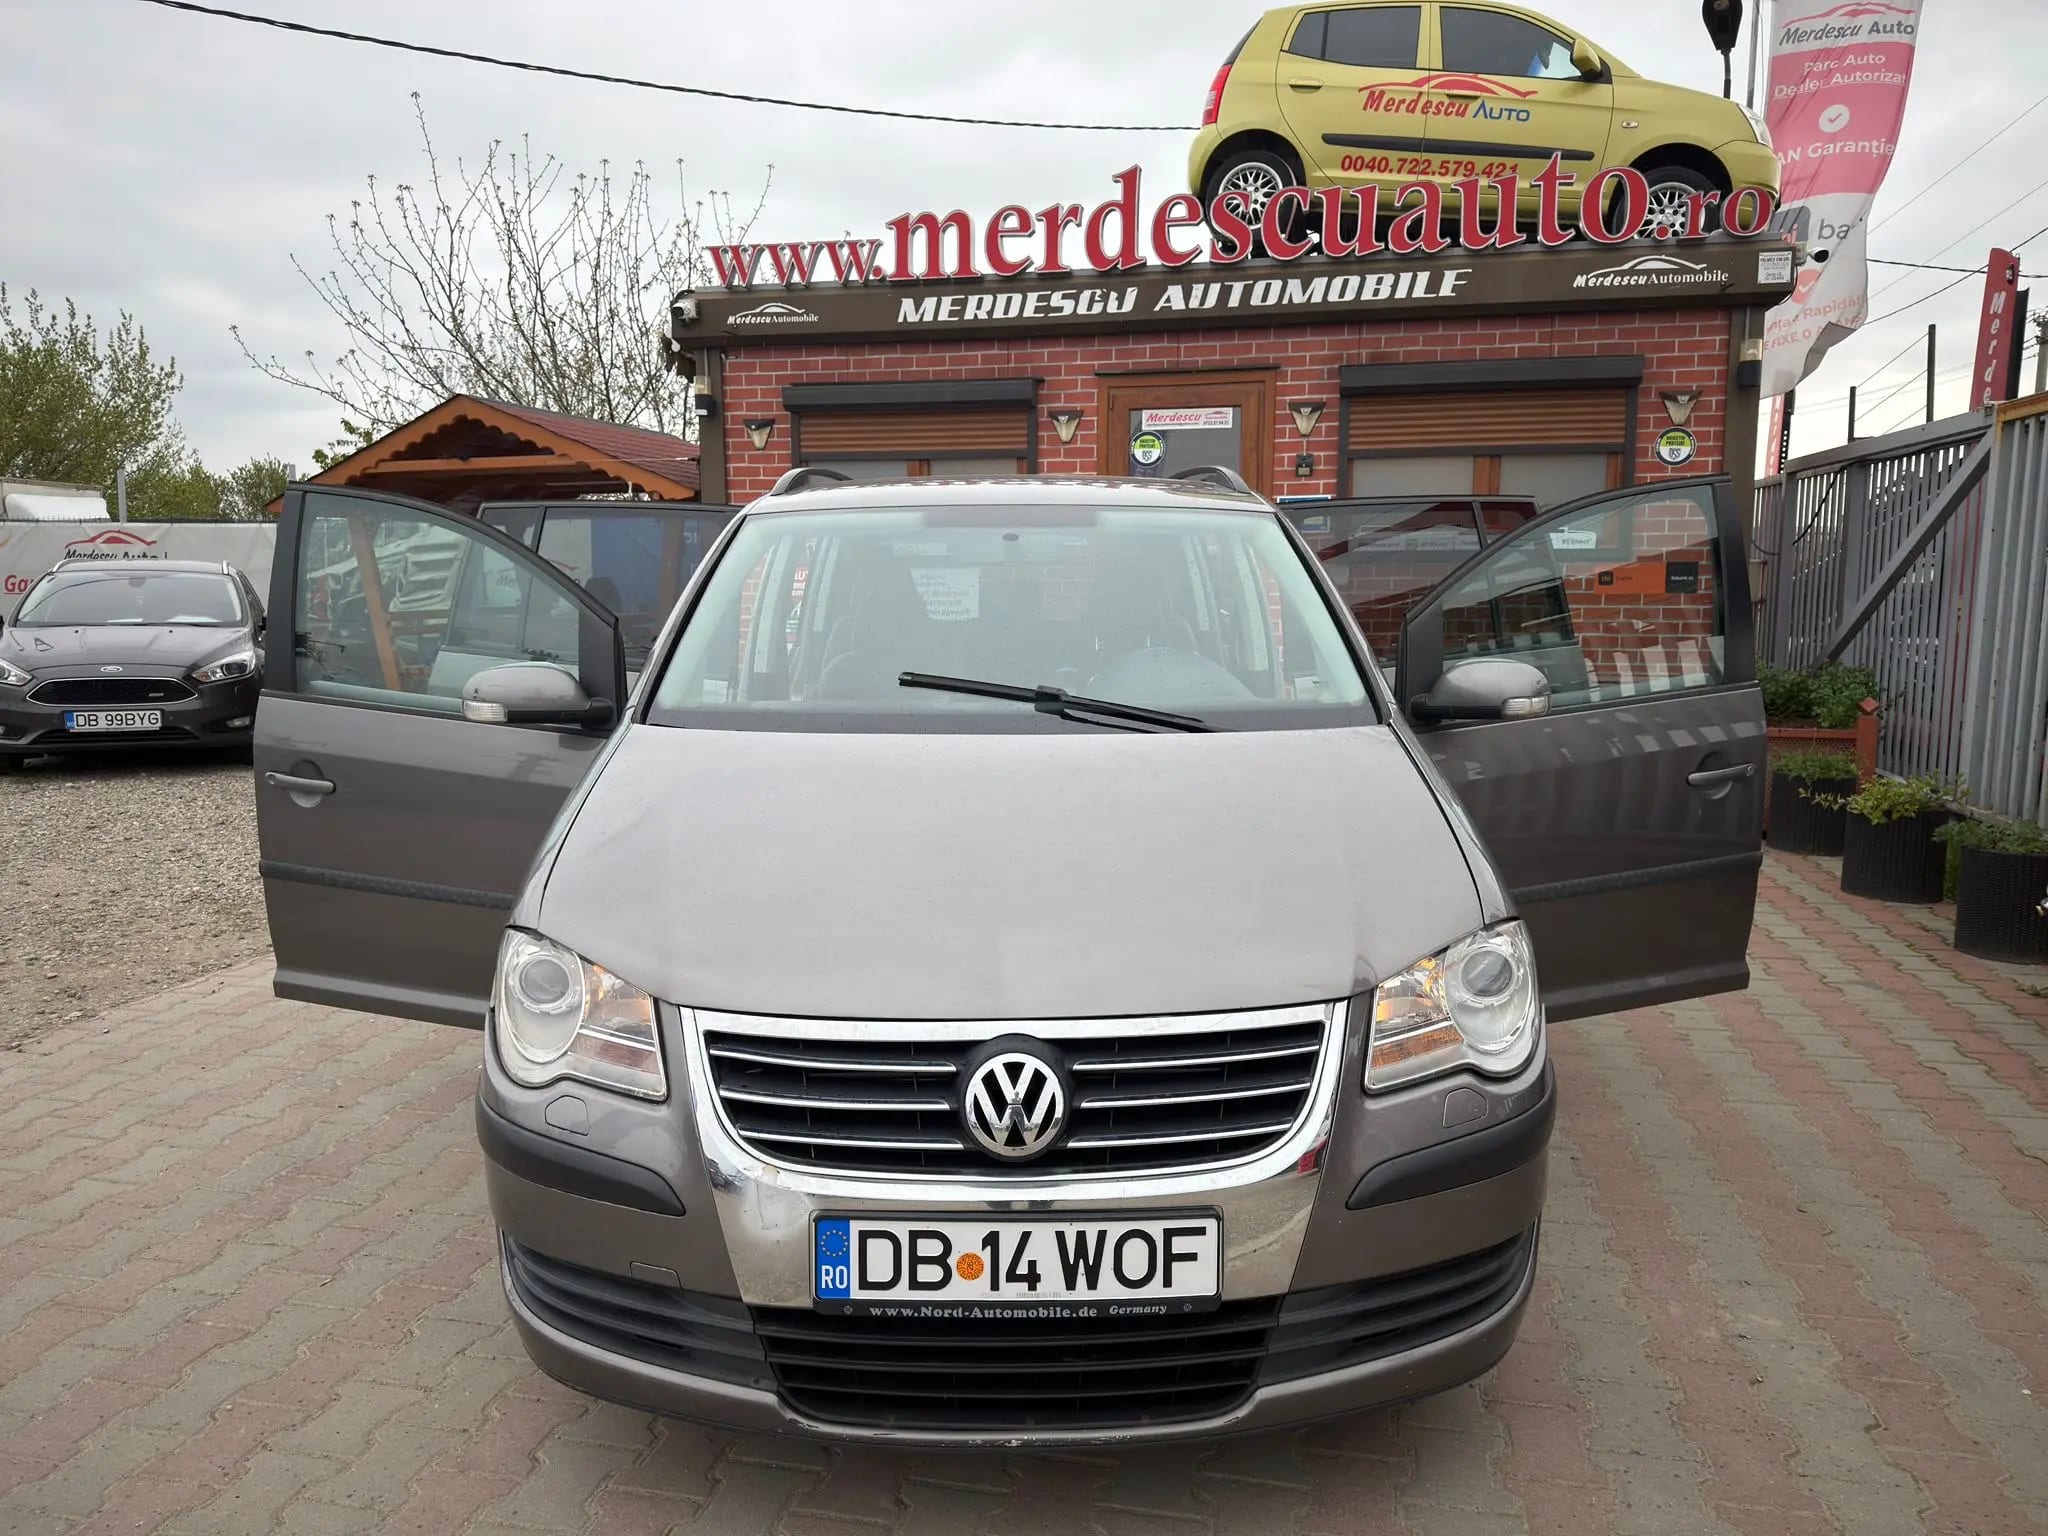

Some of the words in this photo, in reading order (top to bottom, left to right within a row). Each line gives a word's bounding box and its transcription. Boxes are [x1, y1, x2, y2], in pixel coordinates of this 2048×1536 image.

[1779, 23, 1862, 46] Merdescu
[1868, 20, 1915, 35] Auto
[1844, 53, 1886, 67] Auto
[1362, 90, 1470, 118] Merdescu
[1340, 154, 1519, 179] 0040.722.579.421
[704, 152, 1773, 288] www.merdescuauto.ro
[1572, 273, 1648, 288] Merdescu
[1648, 270, 1729, 285] Automobile
[896, 286, 1139, 324] MERDESCU
[1153, 267, 1472, 313] AUTOMOBILE
[727, 315, 772, 325] Merdescu
[772, 313, 820, 324] Automobile
[1146, 411, 1202, 423] Merdescu
[75, 713, 99, 727] DB
[104, 712, 159, 727] 99BYG
[820, 1264, 848, 1290] RO
[857, 1229, 953, 1292] DB
[980, 1229, 1042, 1292] 14
[1055, 1227, 1208, 1291] WOF
[869, 1304, 1098, 1319] www.Nord-Automobile.de
[1108, 1304, 1168, 1316] Germany
